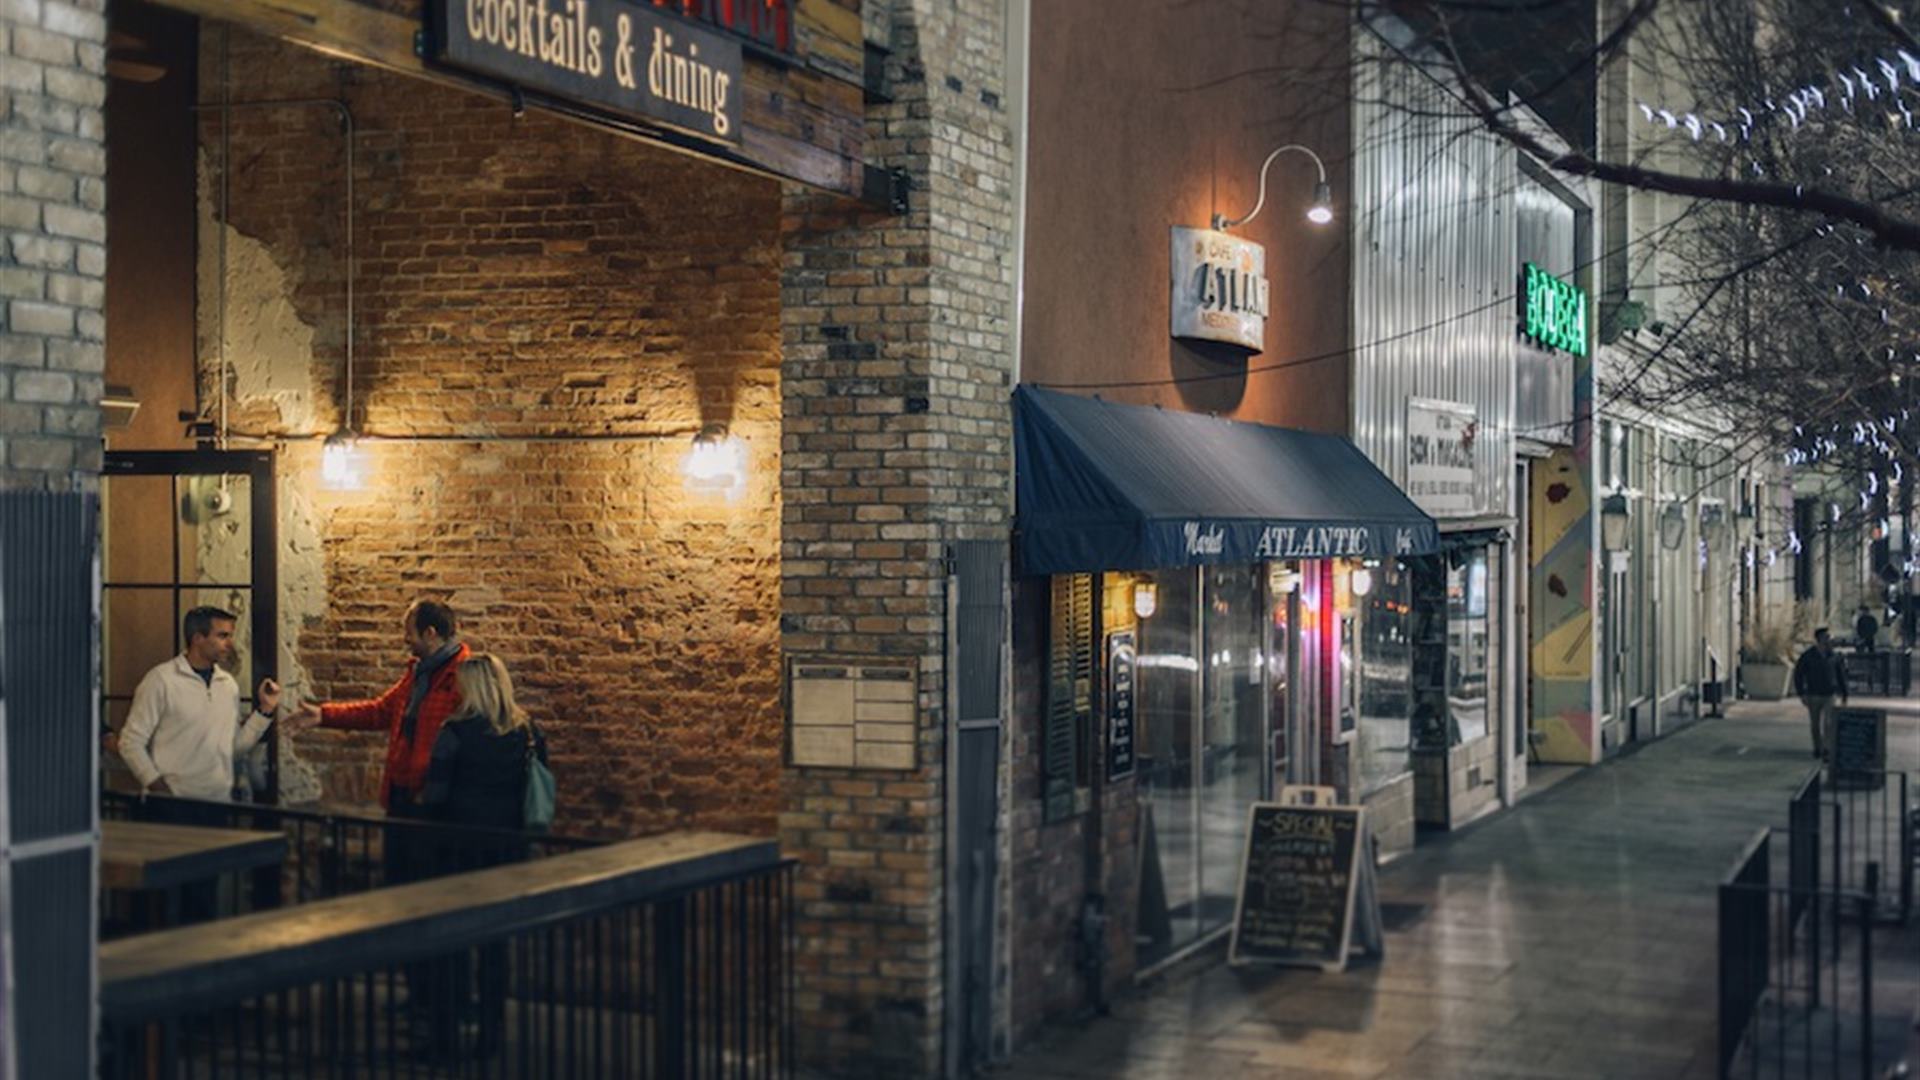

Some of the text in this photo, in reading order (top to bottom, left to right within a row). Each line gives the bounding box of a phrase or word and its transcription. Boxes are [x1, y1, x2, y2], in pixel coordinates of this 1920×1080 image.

[467, 0, 601, 77] cocktails
[614, 13, 637, 88] &
[648, 27, 730, 135] dining
[1255, 526, 1369, 557] ATLANTIC
